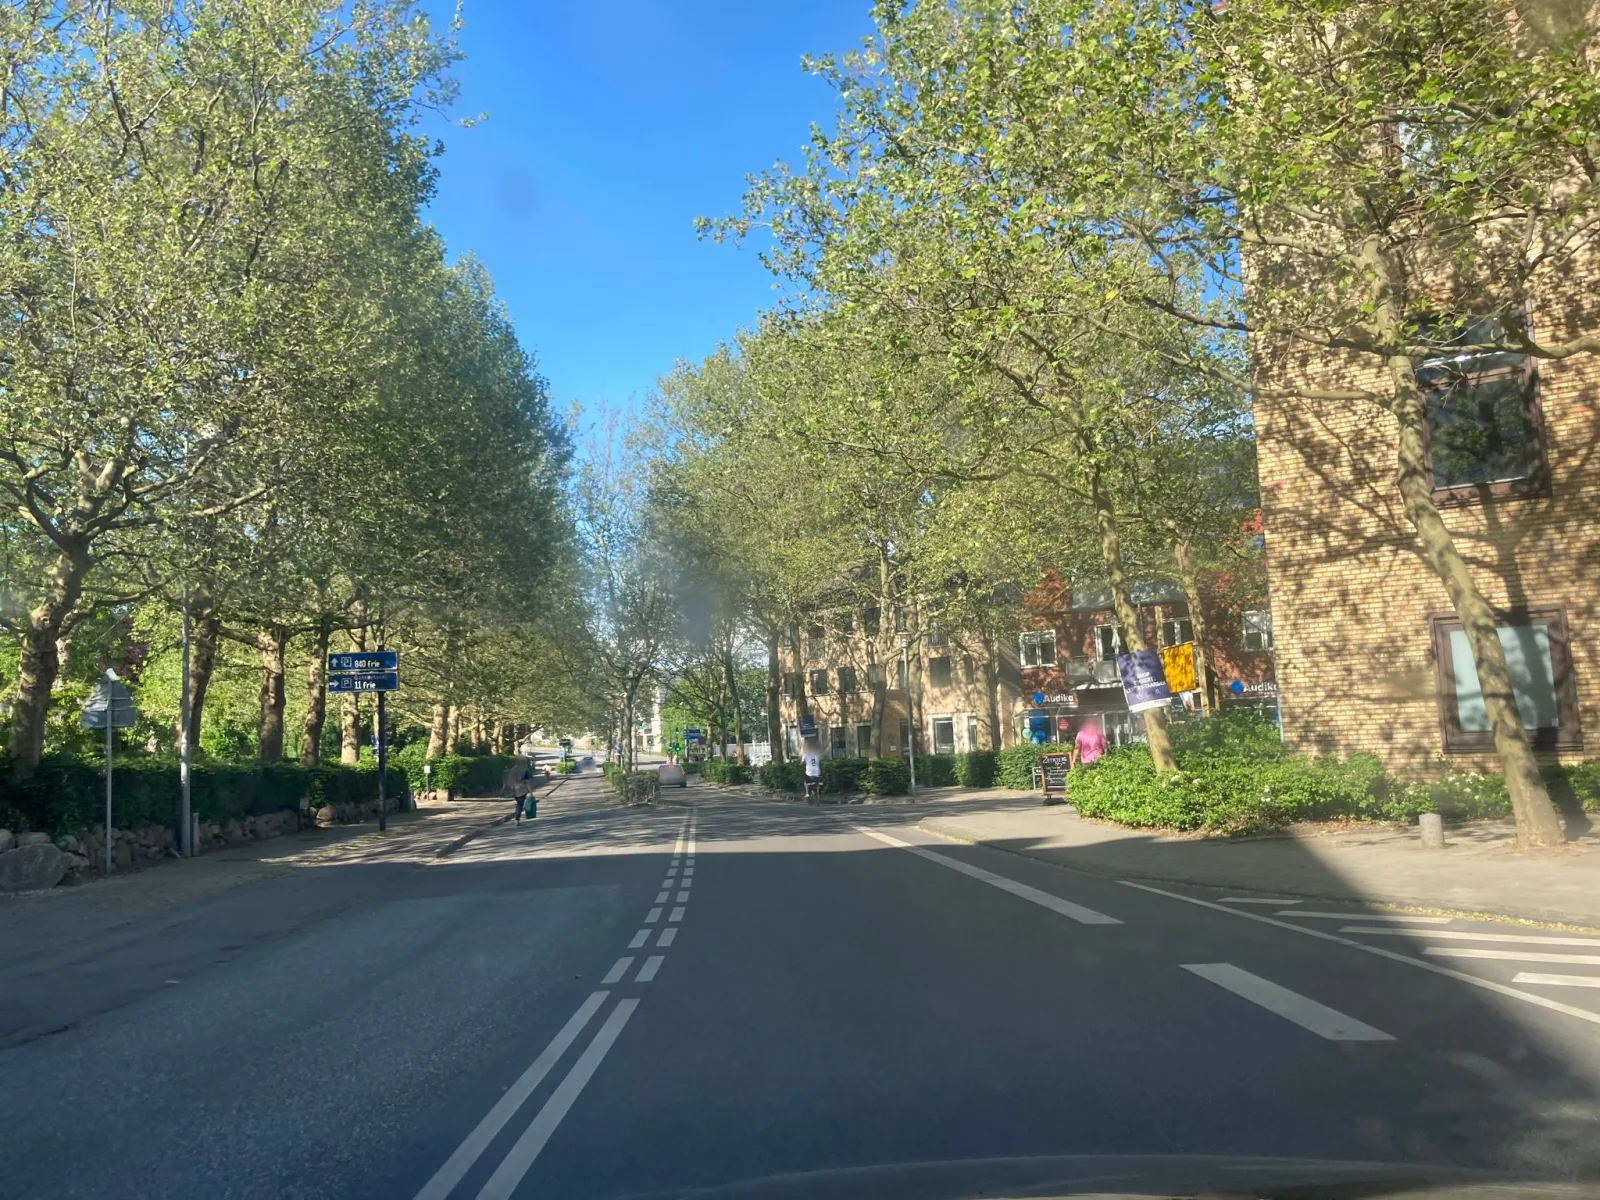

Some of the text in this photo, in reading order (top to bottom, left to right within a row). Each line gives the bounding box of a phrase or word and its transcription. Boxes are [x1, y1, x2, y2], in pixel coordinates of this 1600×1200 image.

[354, 660, 366, 668] 840
[354, 681, 361, 689] 11
[1044, 693, 1074, 703] Audika
